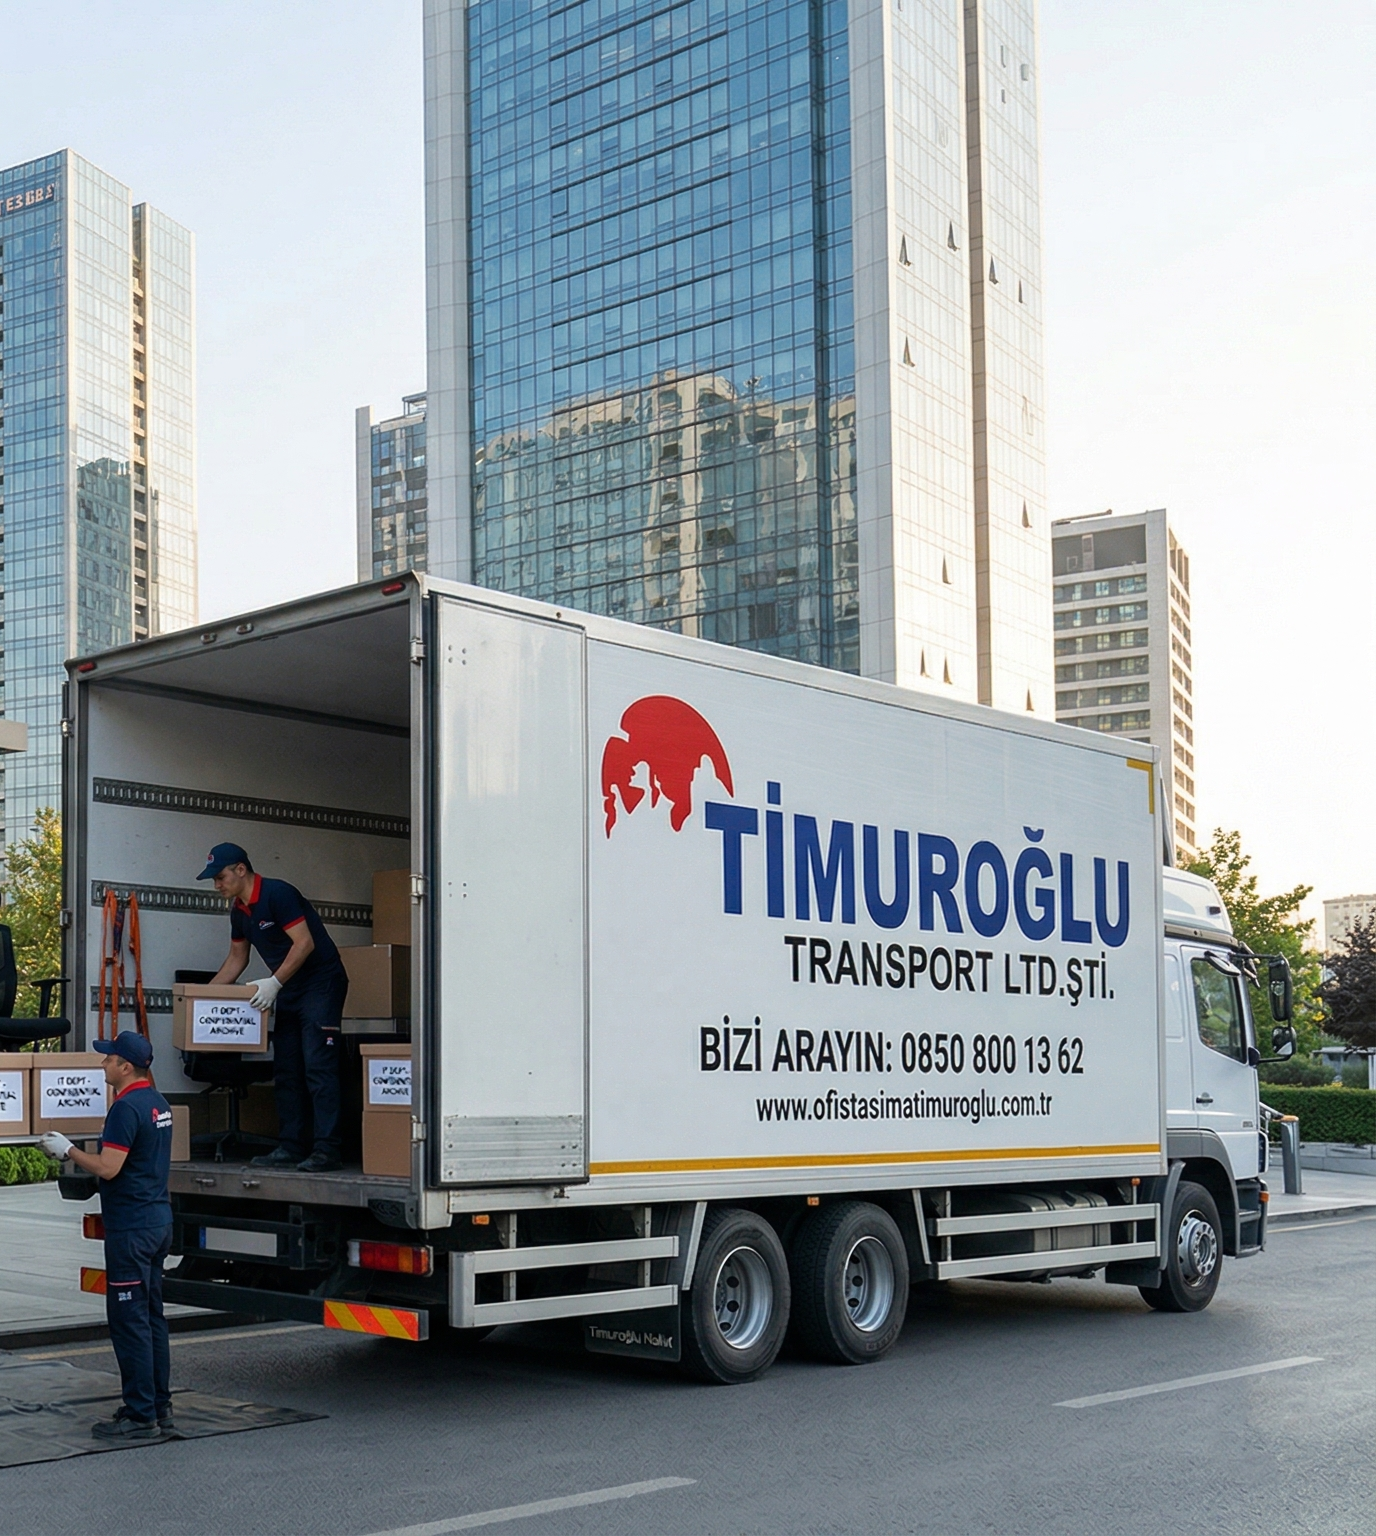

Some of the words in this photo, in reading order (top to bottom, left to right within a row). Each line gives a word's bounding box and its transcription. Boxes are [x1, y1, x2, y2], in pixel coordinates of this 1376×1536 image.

[704, 780, 1130, 948] TİMUROĞLU
[784, 936, 994, 993] TRANSPORT
[700, 1015, 762, 1072] BİZİ
[771, 1028, 892, 1073] ARAYIN:
[901, 1032, 965, 1073] 0850
[972, 1034, 1016, 1074] 800
[1025, 1036, 1052, 1074] 13
[1058, 1037, 1085, 1074] 62
[756, 1089, 1052, 1124] www.ofistasimatimuroglu.com.tr
